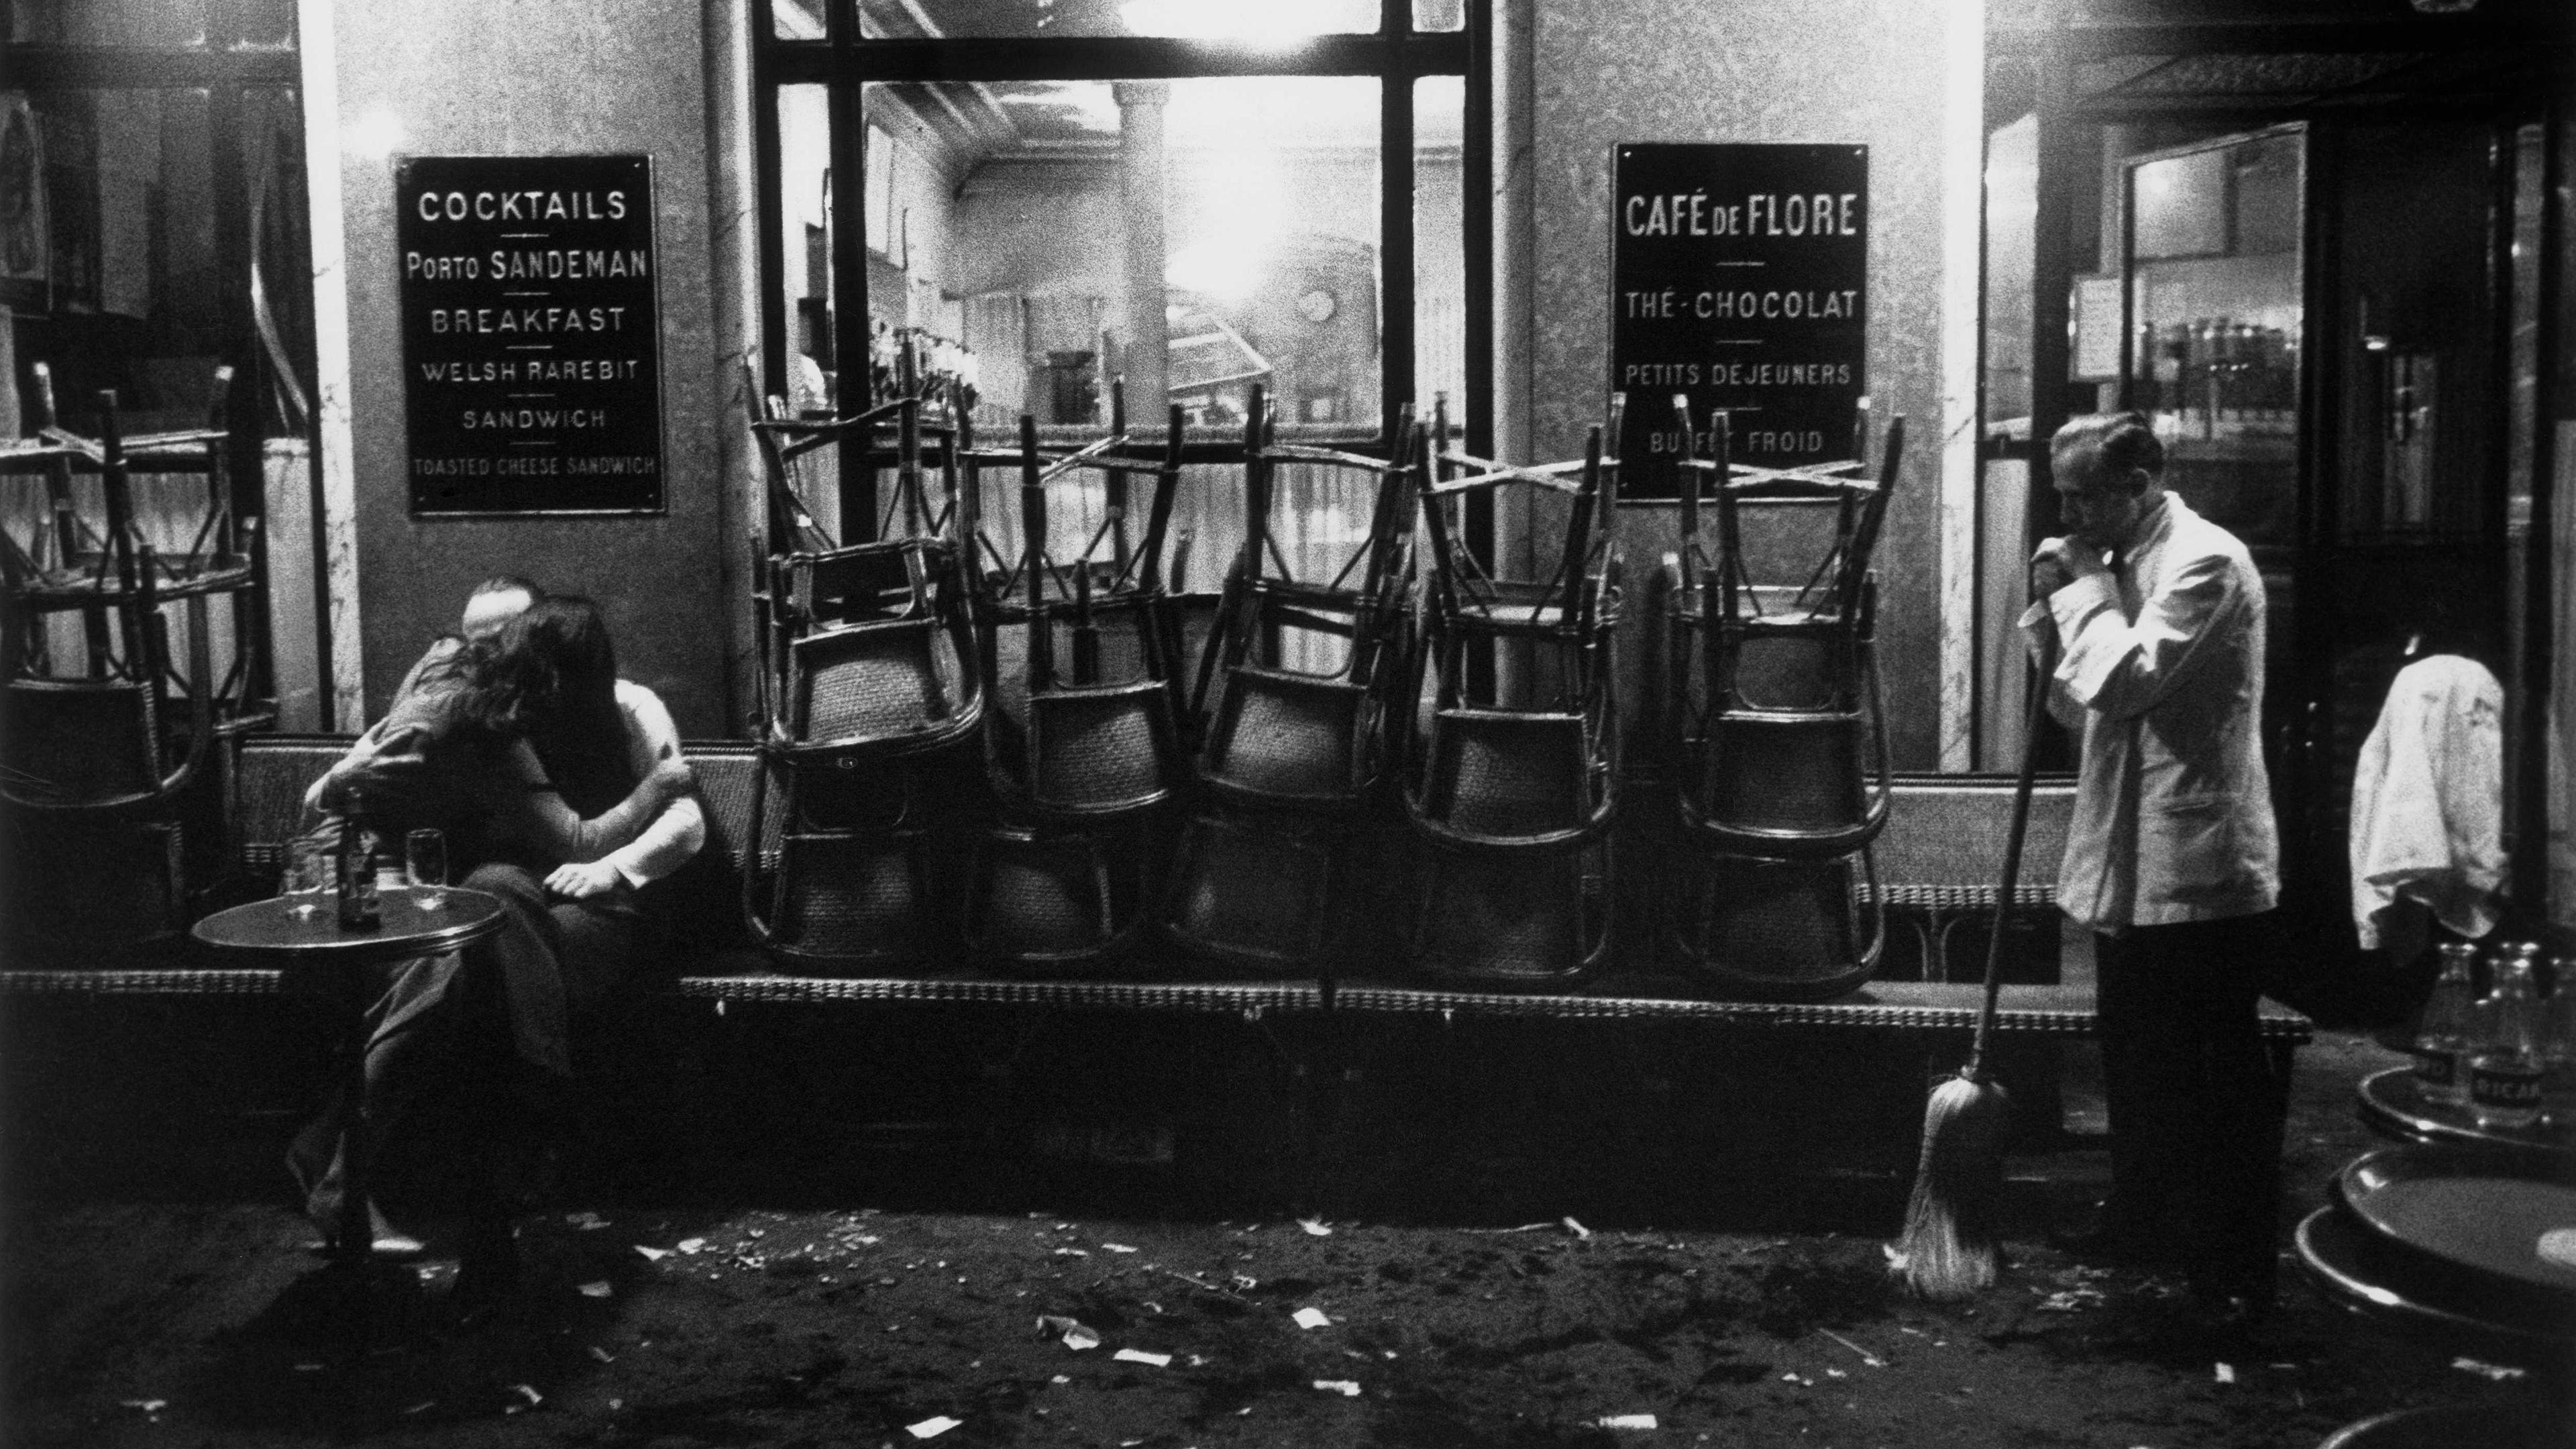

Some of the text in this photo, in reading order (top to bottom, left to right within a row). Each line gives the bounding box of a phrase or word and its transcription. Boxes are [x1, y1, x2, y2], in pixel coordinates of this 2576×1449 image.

[419, 191, 626, 221] COCKTAILS
[1625, 188, 1857, 236] CAFÉ DE FLORE
[407, 250, 646, 279] PORTO SANDEMAN
[431, 308, 625, 333] BREAKFAST
[423, 360, 638, 382] WELSH RAREBIT
[1625, 364, 1699, 385] PETITS
[463, 409, 605, 429] SANDWICH
[1749, 431, 1823, 452] FROID
[415, 456, 655, 475] TOASTED CHEESE SANDWICH
